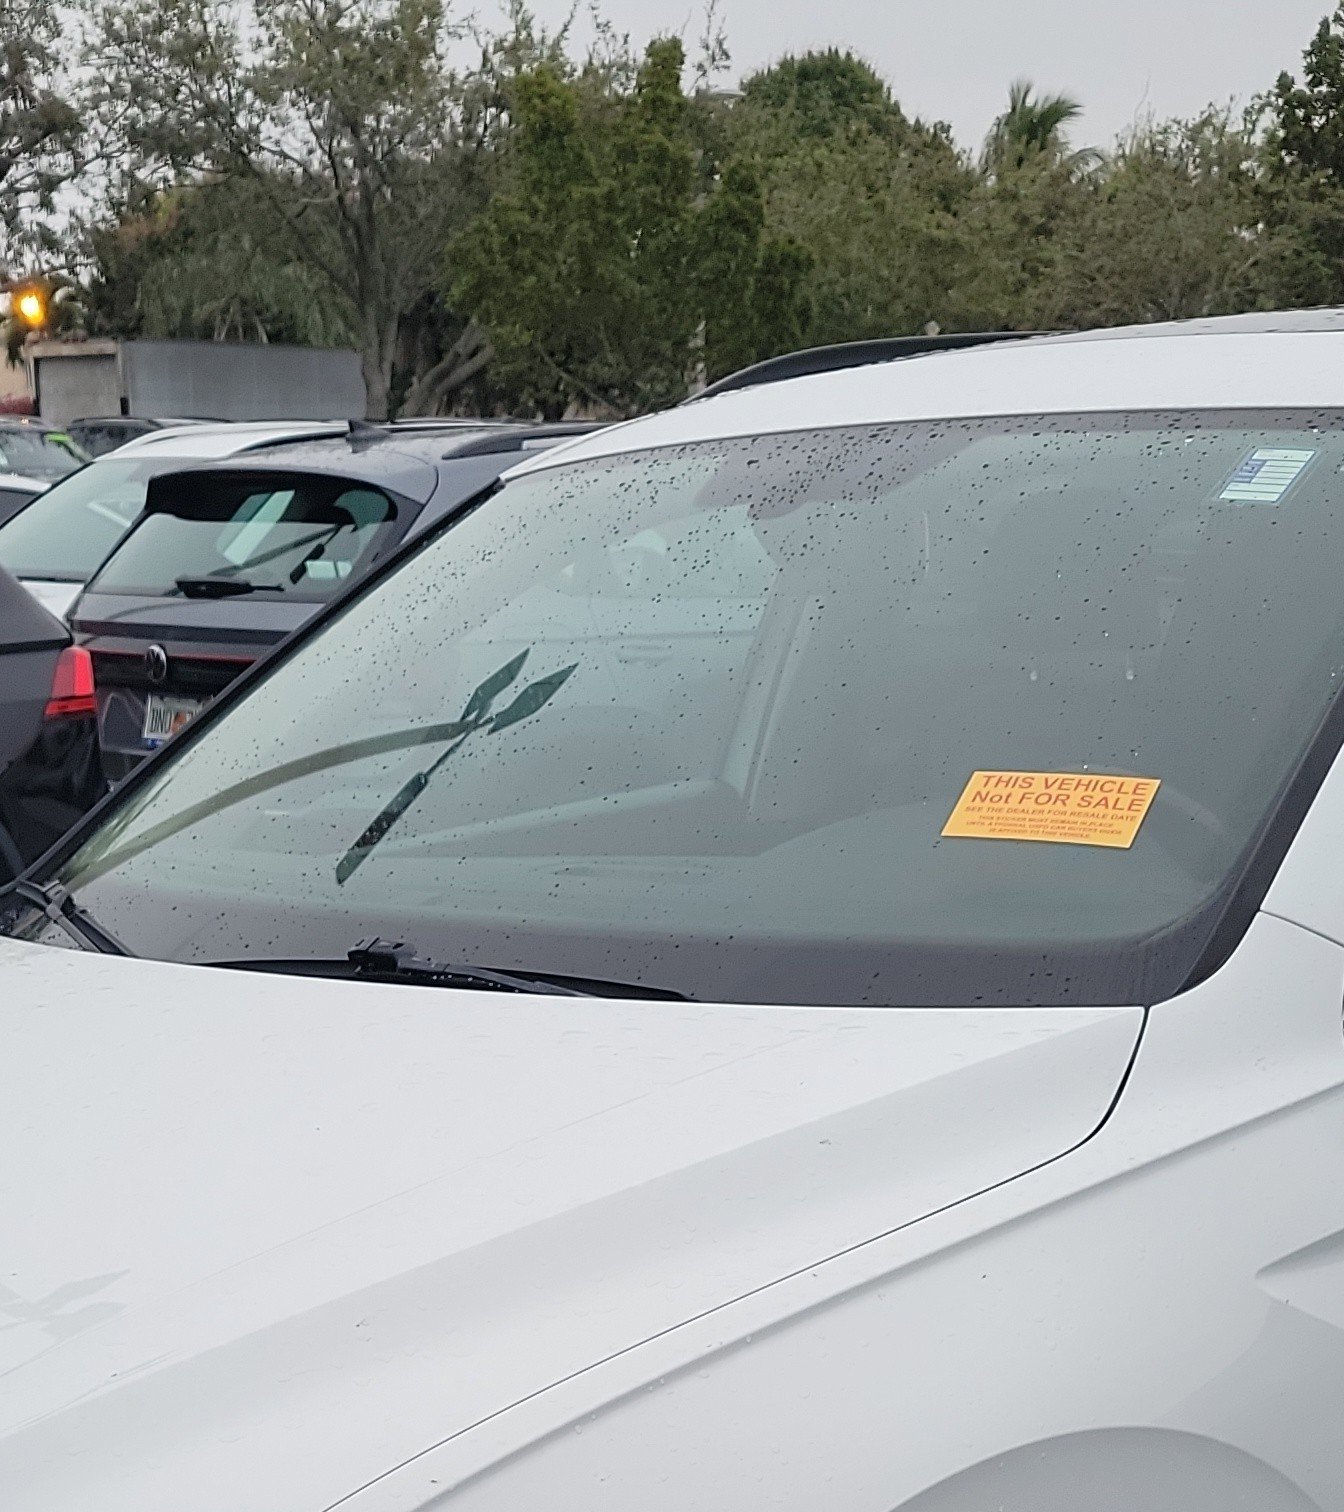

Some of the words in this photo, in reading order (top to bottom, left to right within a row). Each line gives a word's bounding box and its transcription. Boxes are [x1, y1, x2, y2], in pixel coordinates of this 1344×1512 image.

[983, 775, 1035, 789] THIS
[1044, 776, 1151, 796] VEHICLE
[971, 790, 1012, 805] Not
[1018, 791, 1071, 807] FOR
[1076, 794, 1146, 812] SALE
[1006, 807, 1045, 815] DEALER
[1069, 810, 1109, 819] RESALE
[1110, 814, 1138, 822] DATE
